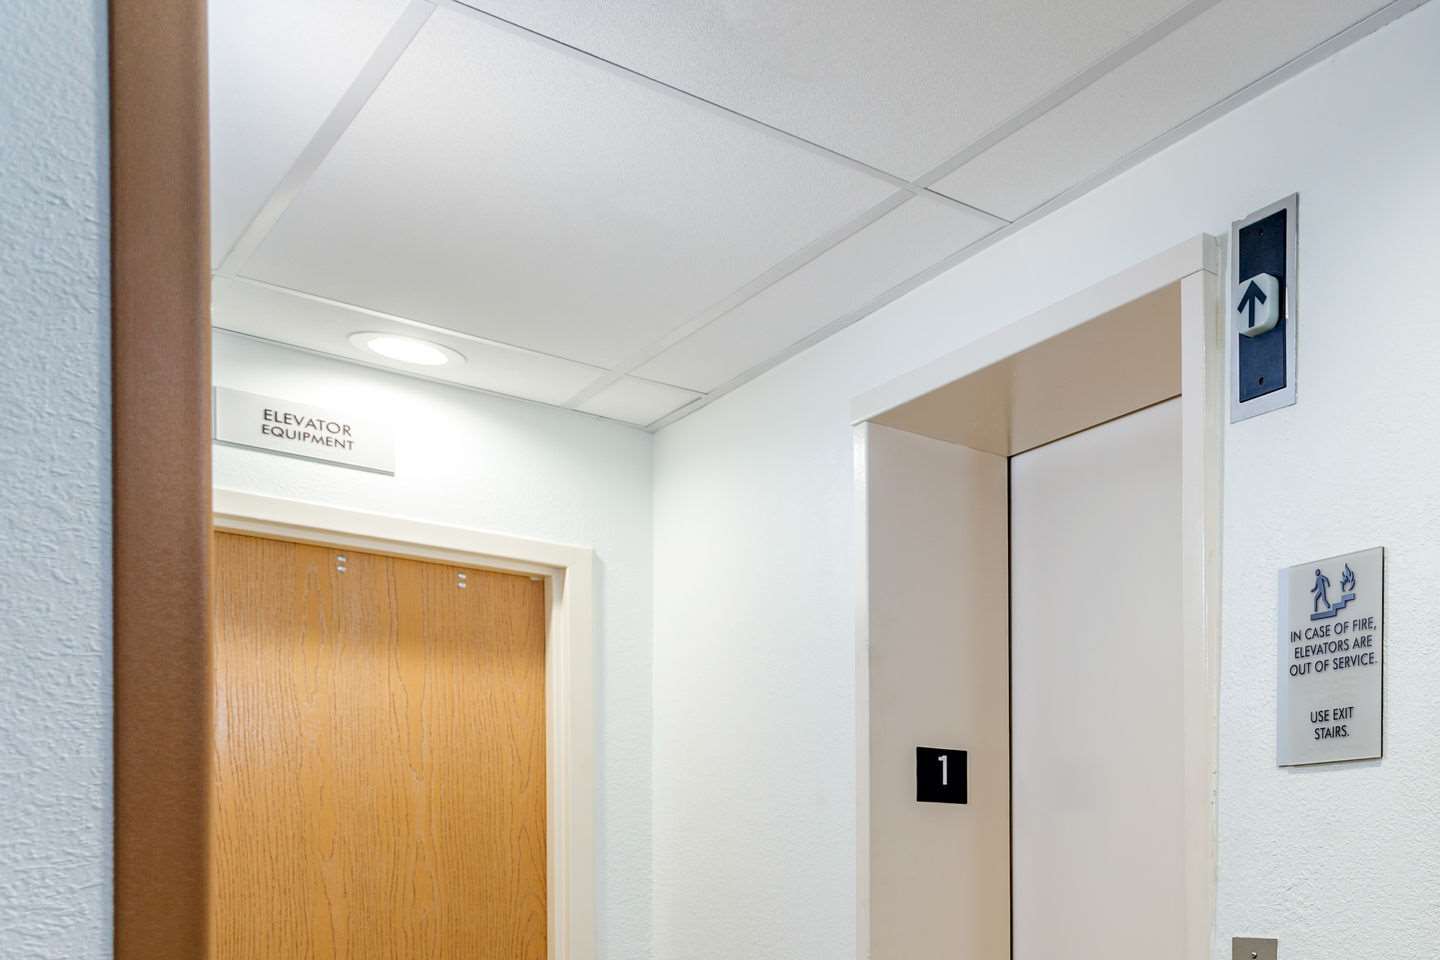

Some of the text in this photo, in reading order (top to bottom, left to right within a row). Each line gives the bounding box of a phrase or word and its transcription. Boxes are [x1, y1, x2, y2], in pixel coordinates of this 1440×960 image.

[263, 408, 352, 437] ELEVATOR
[261, 423, 355, 450] EQUIPMENT
[1290, 617, 1377, 643] IN CASE OF FIRE,
[1294, 634, 1373, 659] ELEVATORS ARE
[1289, 652, 1378, 676] OUT OF SERVICE.
[1310, 706, 1355, 724] USE EXIT
[1314, 725, 1350, 741] STAIRS.
[938, 754, 948, 785] 1
